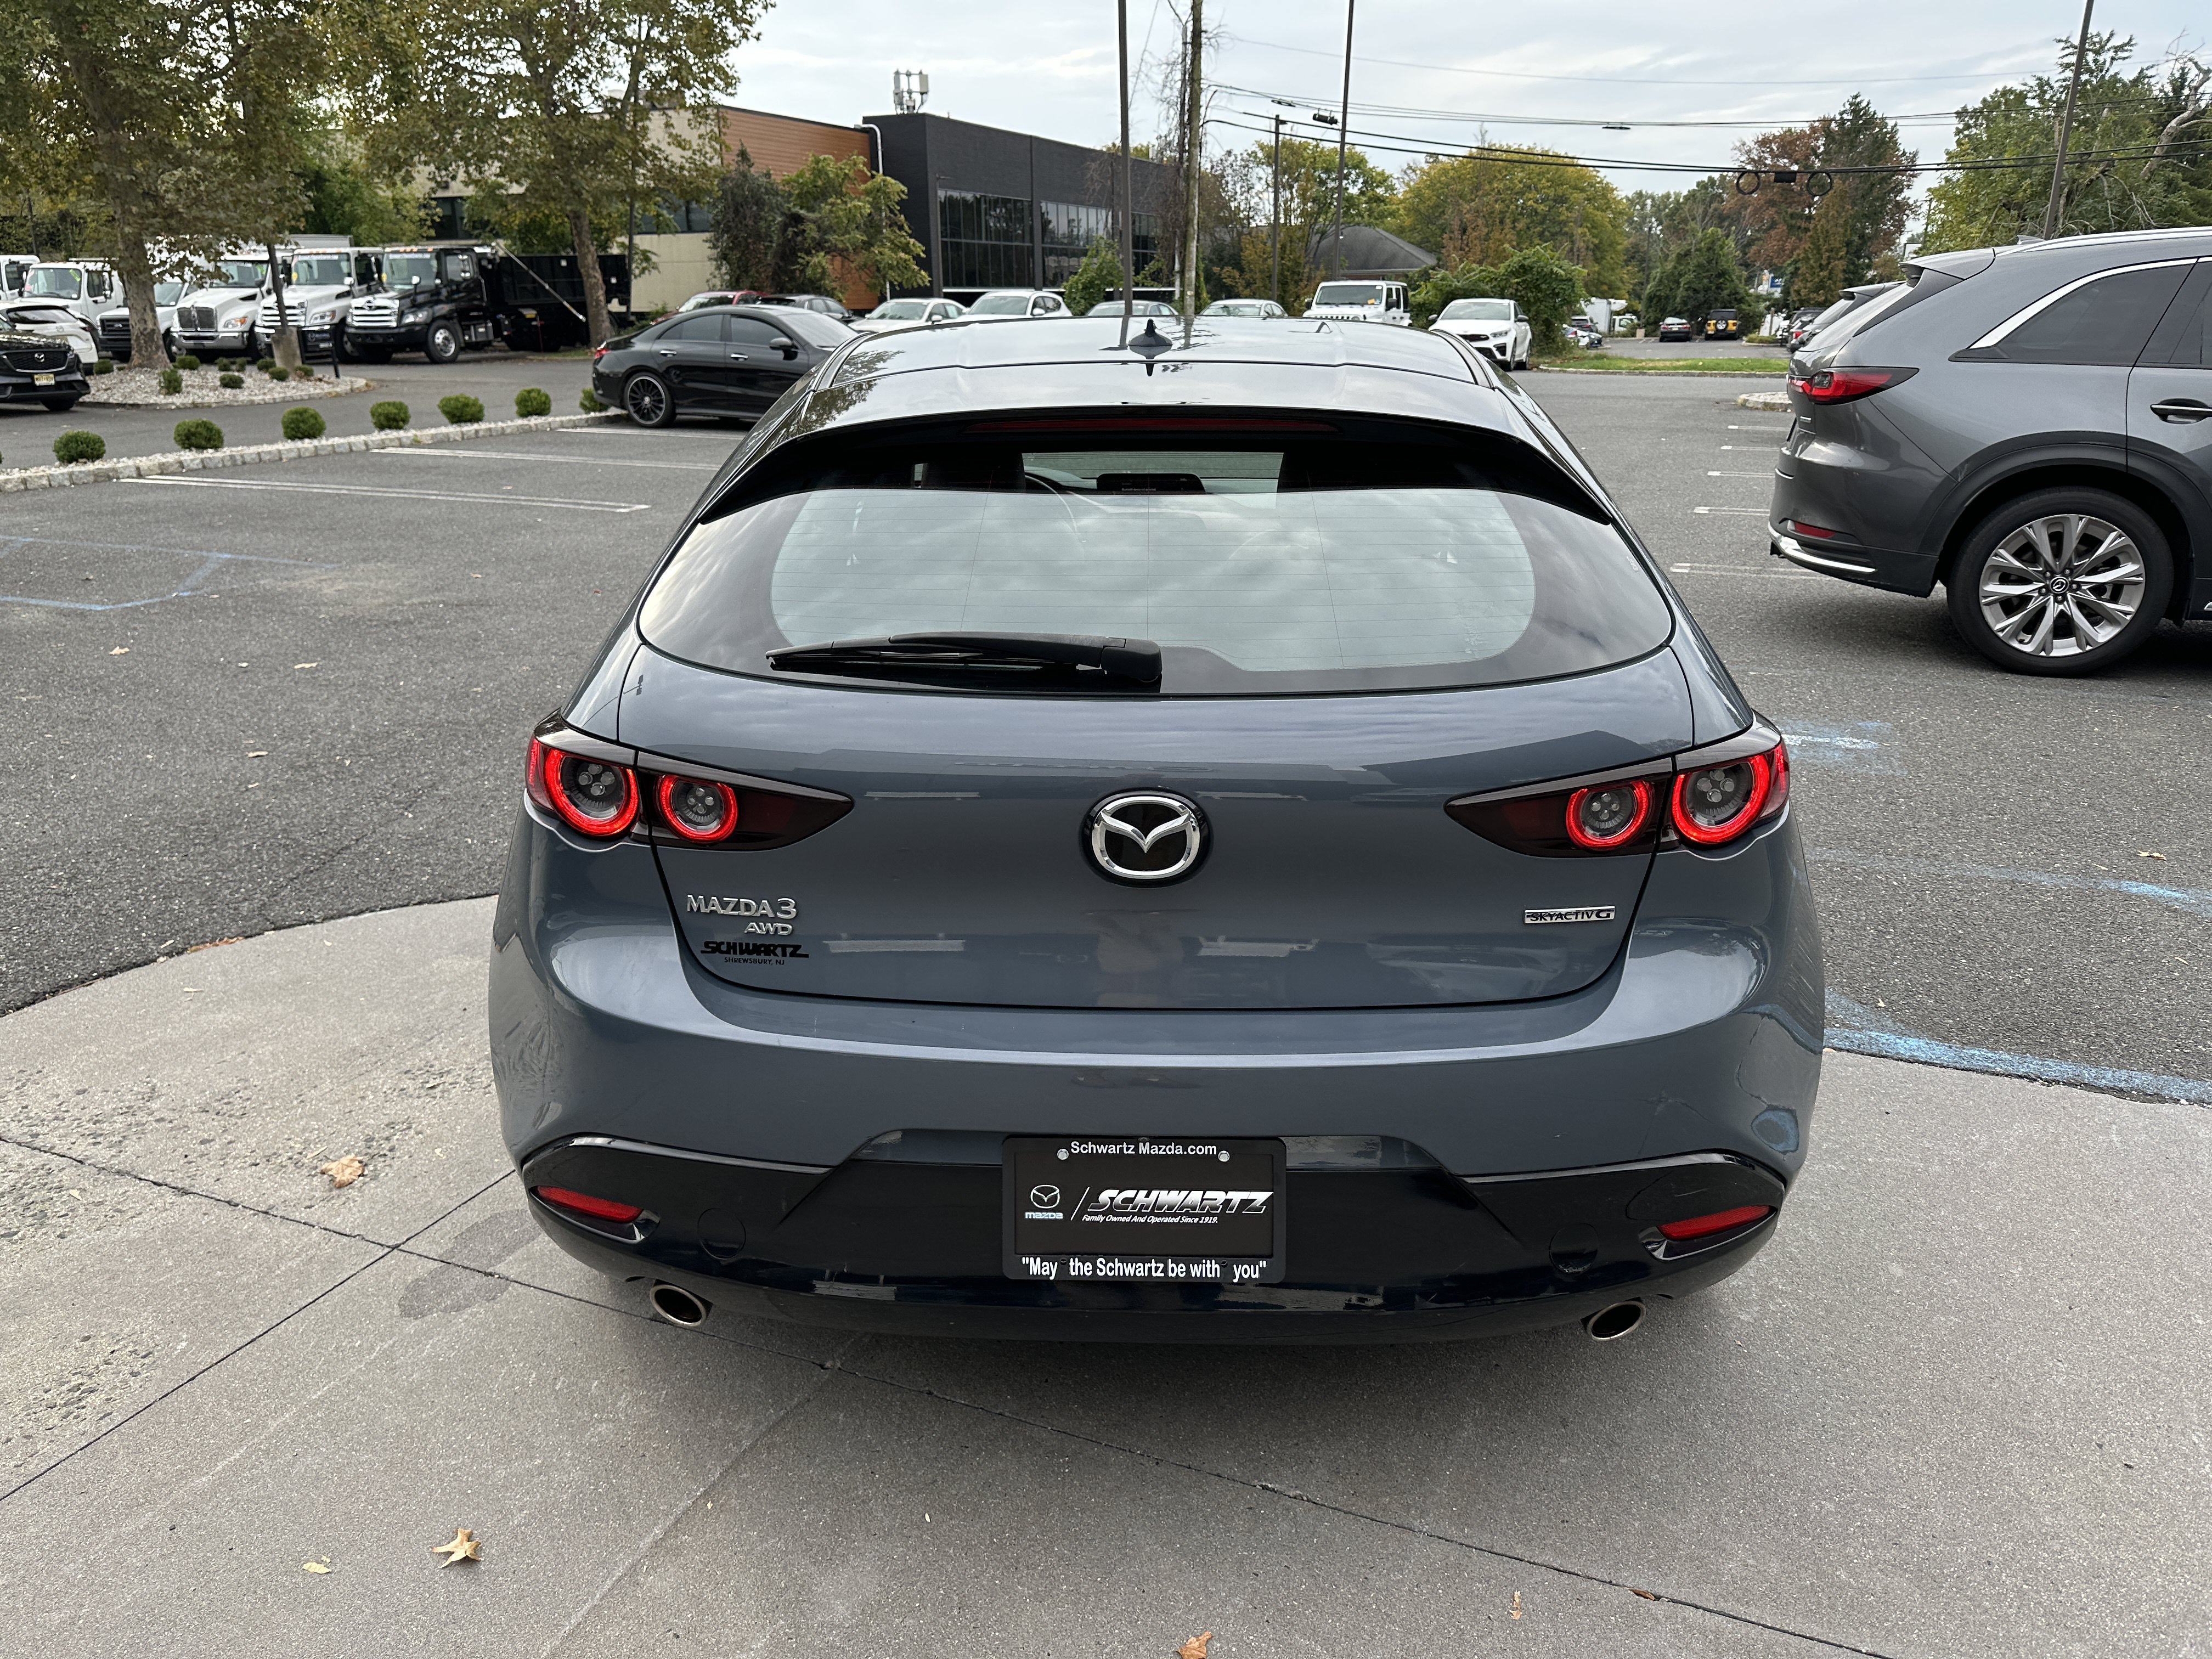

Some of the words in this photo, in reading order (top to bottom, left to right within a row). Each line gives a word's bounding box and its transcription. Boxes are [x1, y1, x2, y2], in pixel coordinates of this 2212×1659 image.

[744, 922, 793, 935] AWD
[701, 940, 809, 958] SCHWARTZ
[724, 957, 773, 966] SHREWSBURY,
[1071, 1141, 1135, 1155] Schwartz
[1138, 1142, 1217, 1155] Mazda.com
[1088, 1189, 1274, 1214] SCHWARTZ
[1082, 1214, 1105, 1223] Family
[1147, 1215, 1180, 1224] Operated
[1022, 1257, 1058, 1280] "May
[1069, 1257, 1092, 1277] the
[1096, 1257, 1165, 1277] Schwartz
[1168, 1259, 1186, 1277] be
[1189, 1259, 1220, 1278] with
[1233, 1260, 1267, 1283] you"
